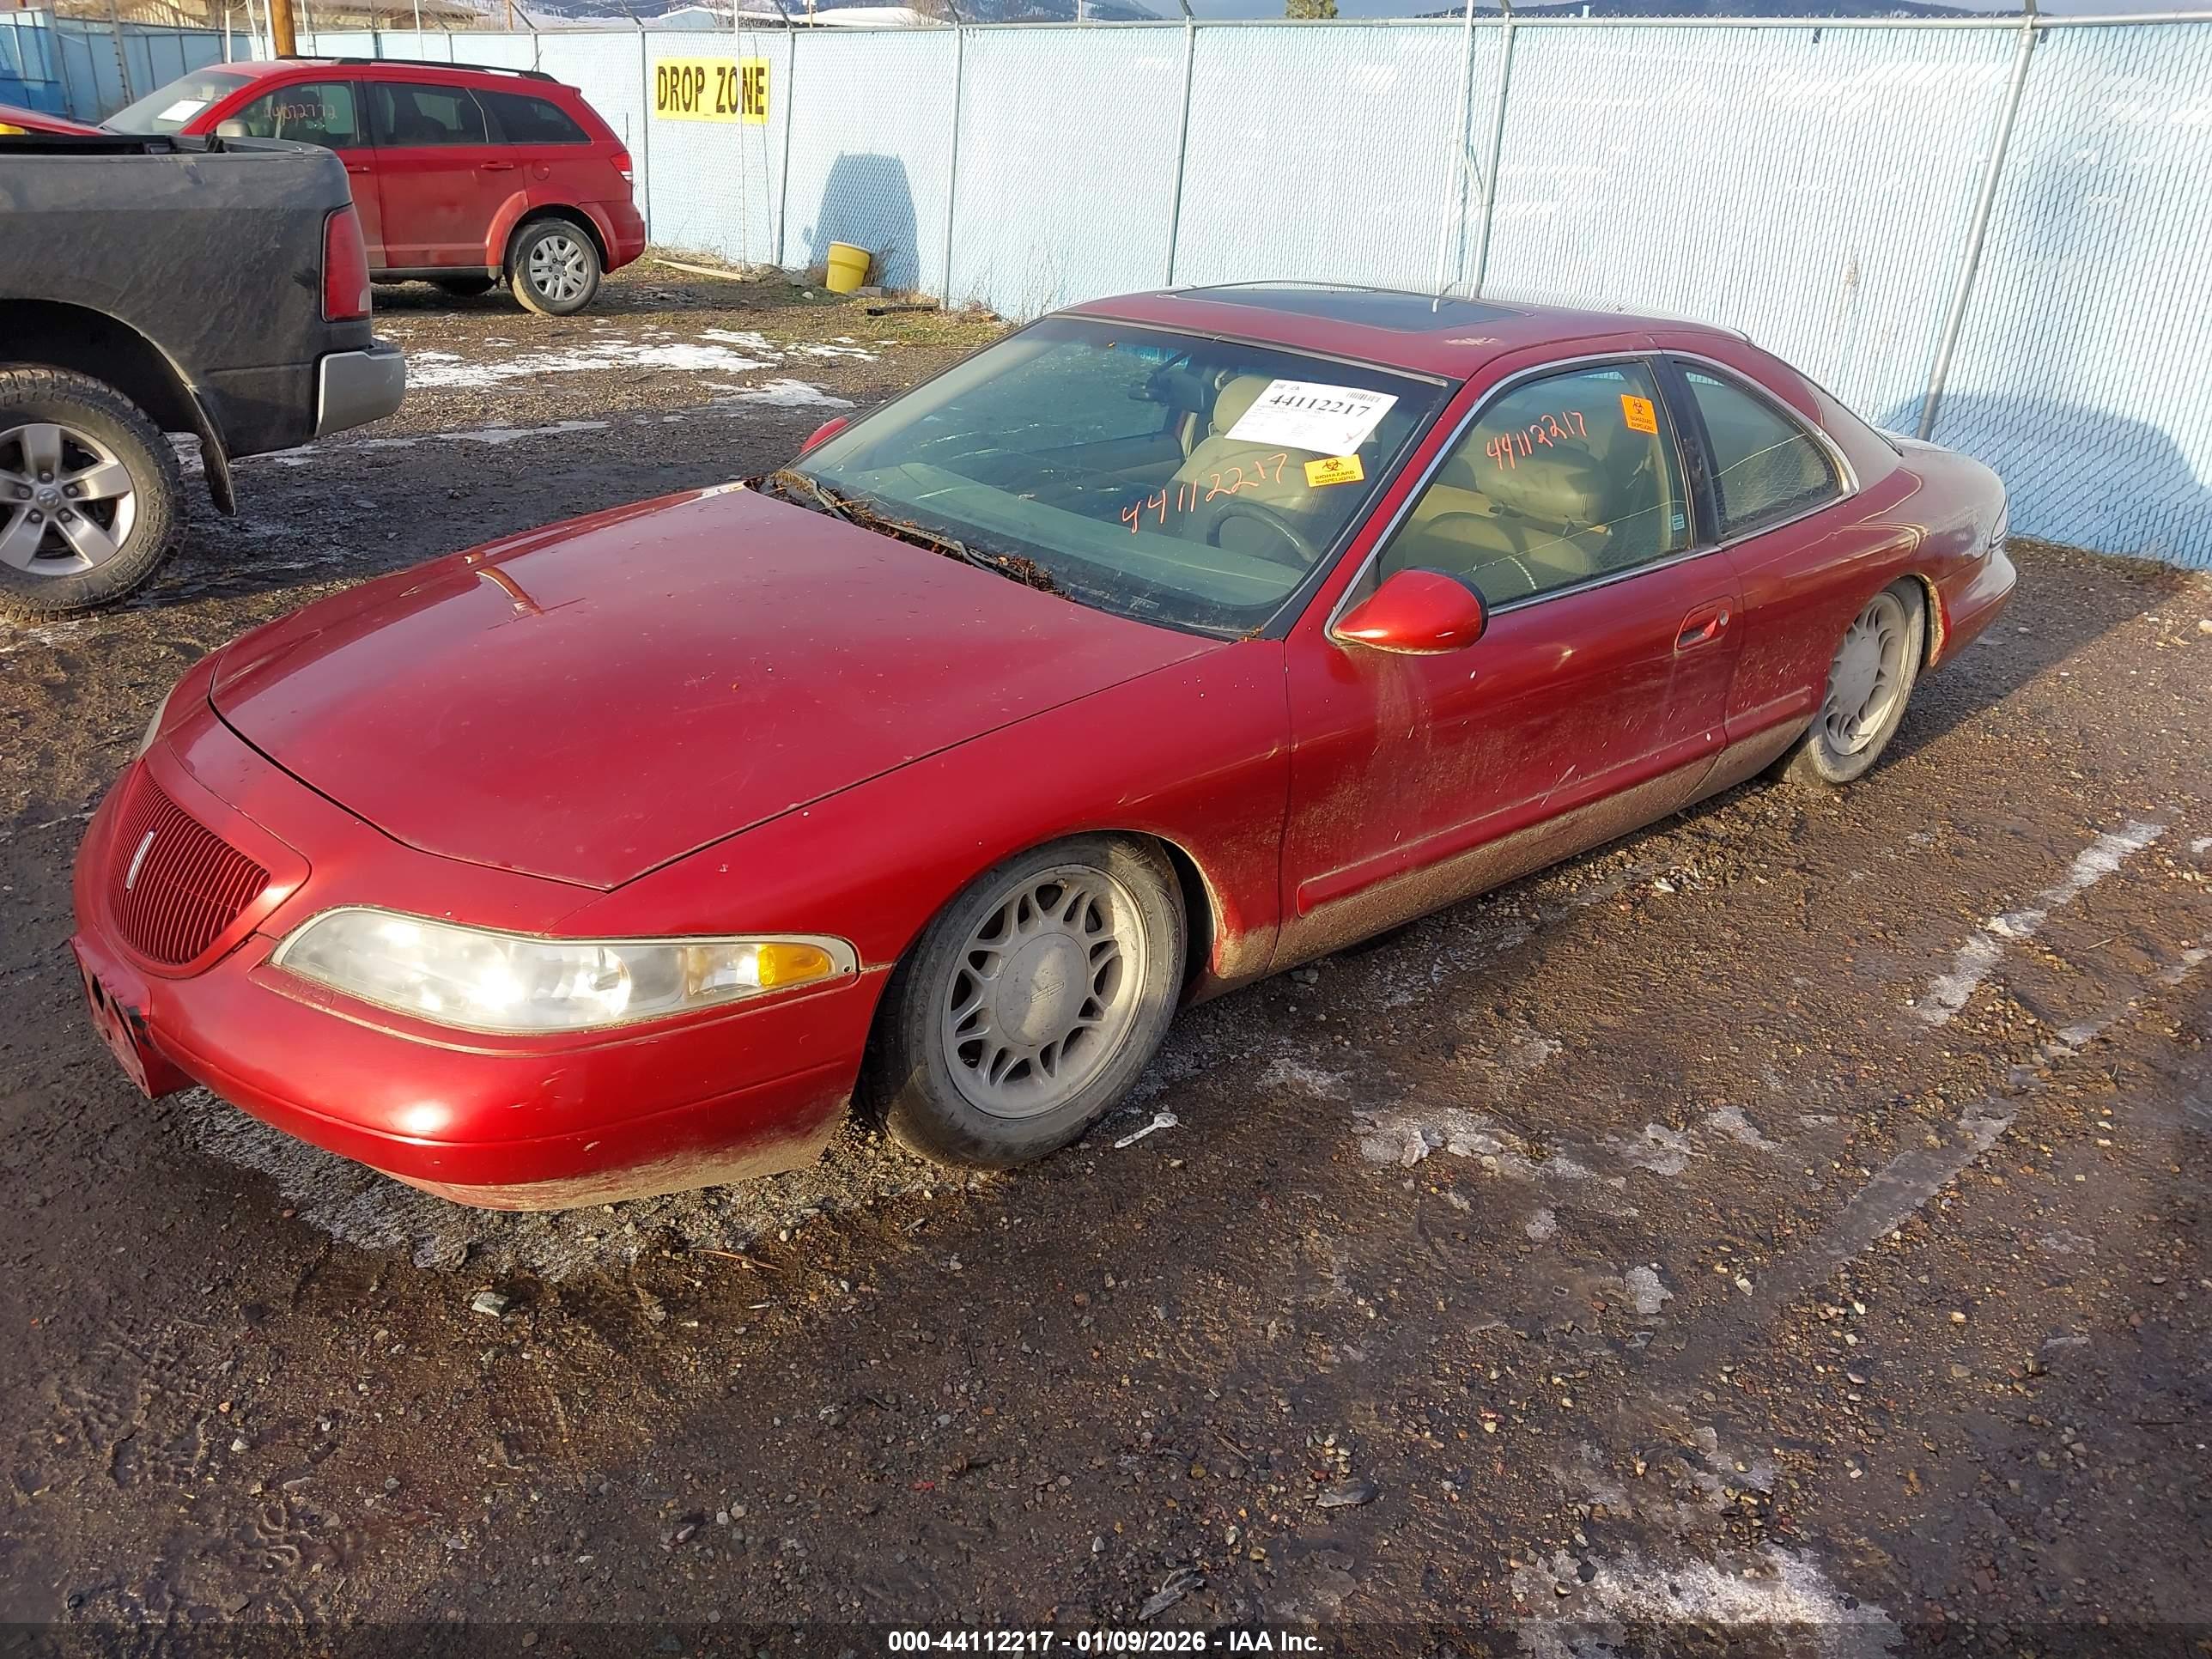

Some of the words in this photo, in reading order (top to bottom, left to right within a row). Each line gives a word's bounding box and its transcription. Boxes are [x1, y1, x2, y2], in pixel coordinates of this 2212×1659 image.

[658, 66, 705, 112] DROP
[716, 66, 765, 115] ZONE
[1269, 394, 1371, 417] 44112217
[1486, 410, 1587, 470] 44112217
[1121, 453, 1287, 533] 44112217
[1315, 470, 1355, 480] BIOHAZARD
